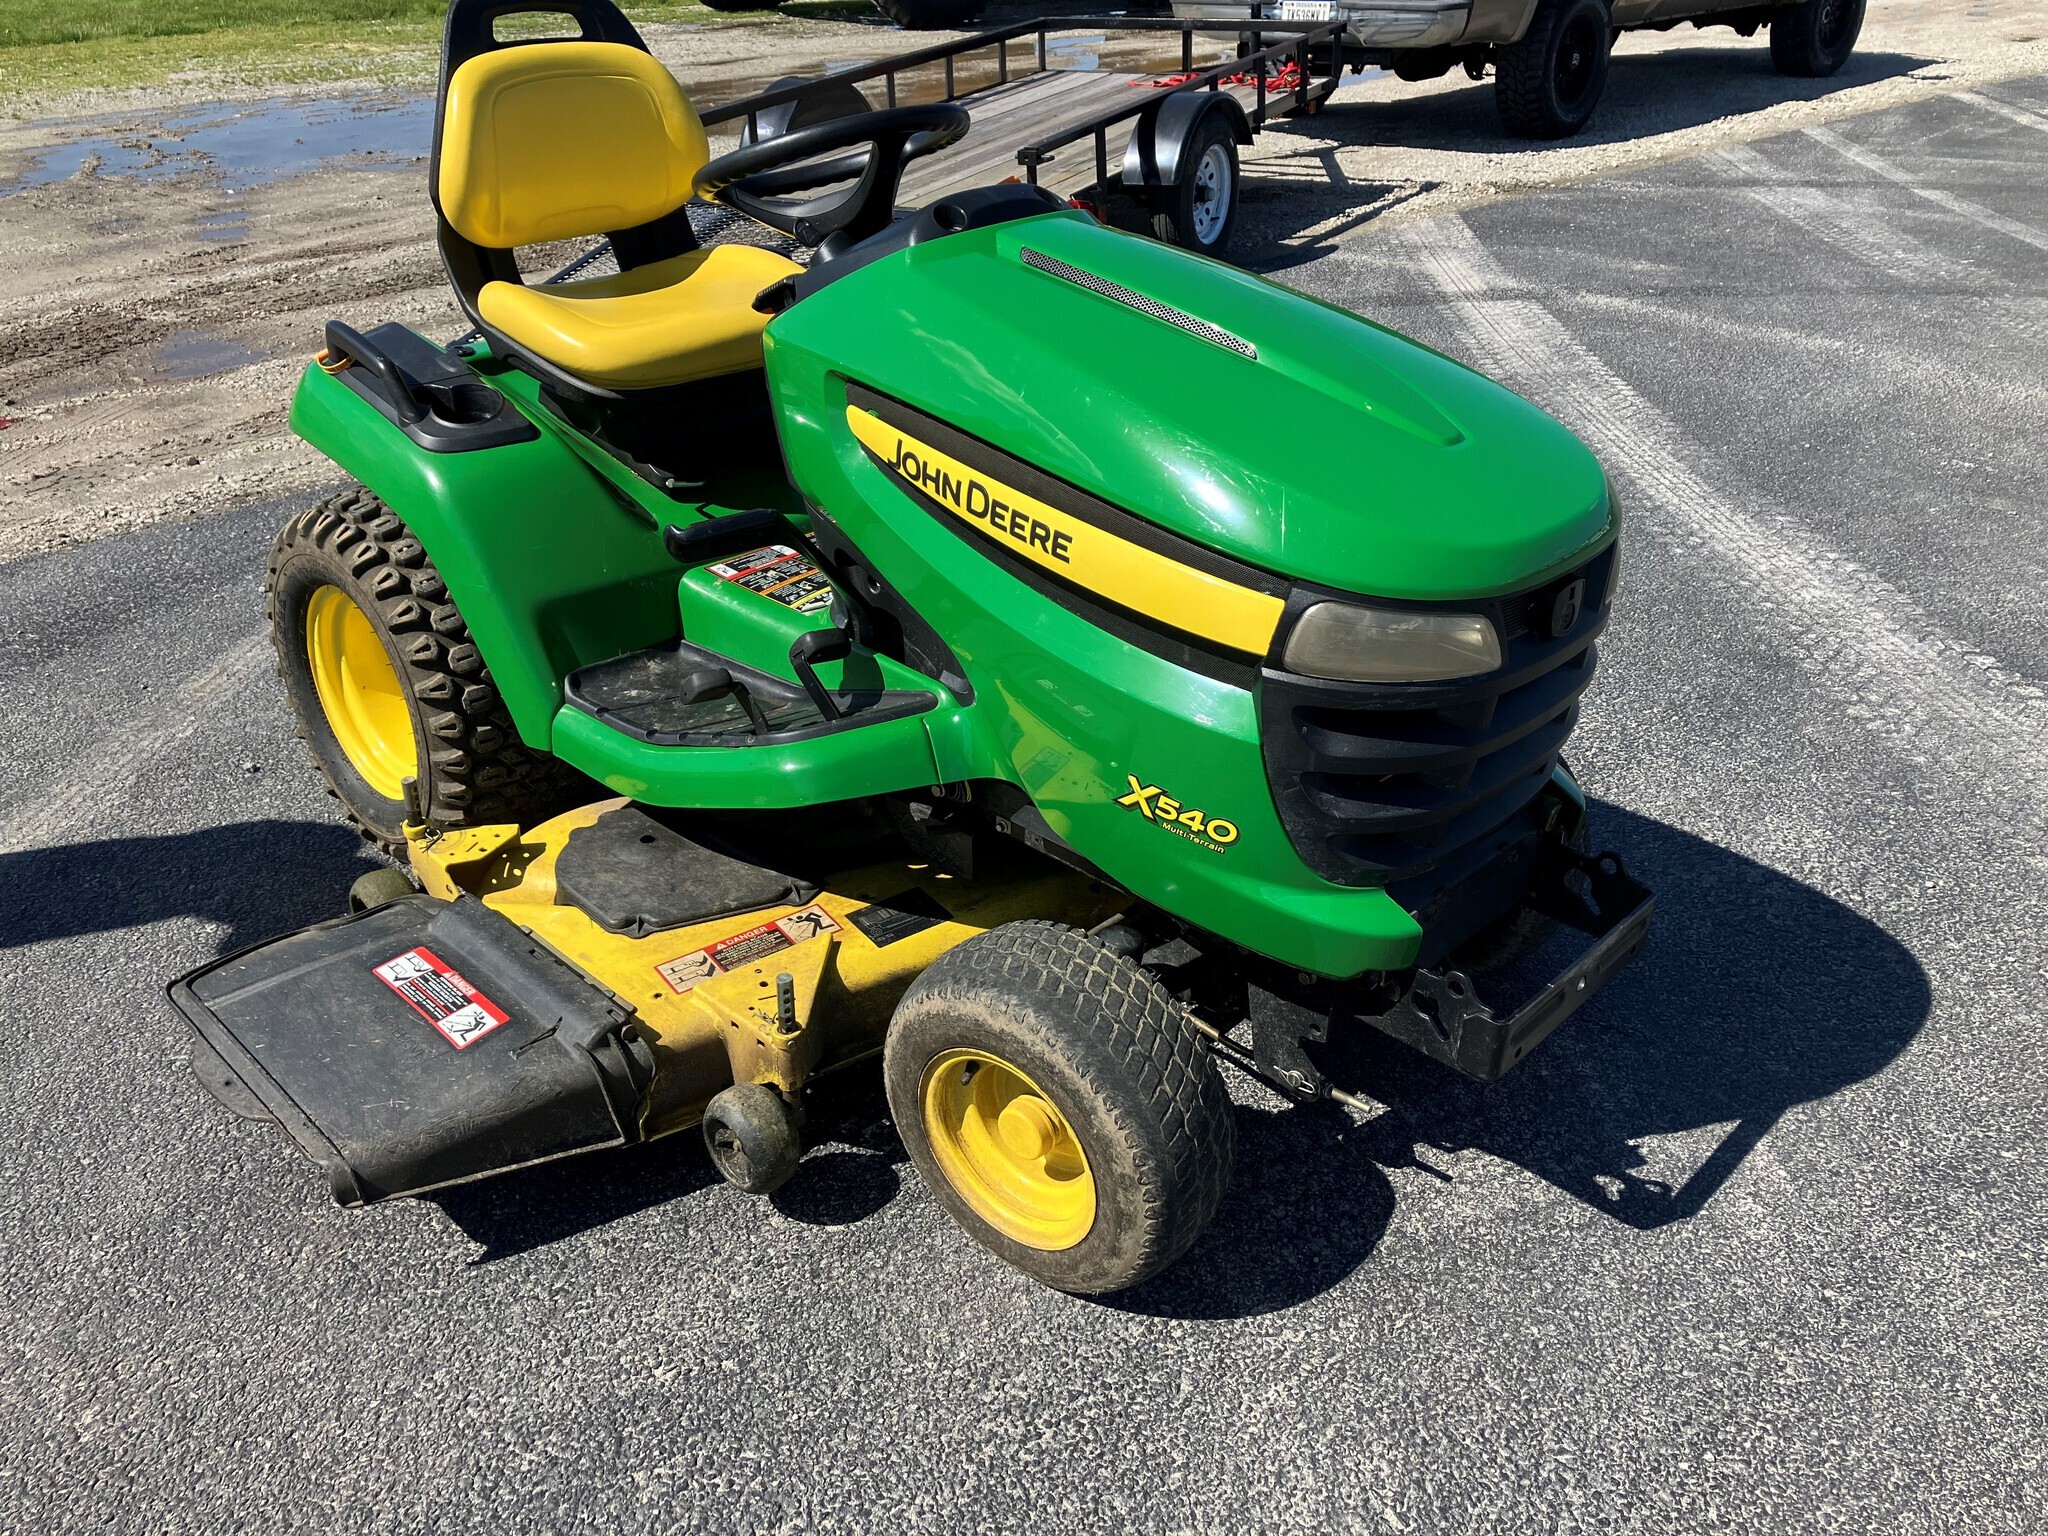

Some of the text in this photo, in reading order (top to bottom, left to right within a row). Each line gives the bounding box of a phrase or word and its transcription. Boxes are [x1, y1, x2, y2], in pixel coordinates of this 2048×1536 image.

[886, 438, 1074, 564] JOHN DEERE
[1114, 773, 1240, 846] X540
[1162, 821, 1226, 855] Multi-Terrain
[726, 925, 769, 945] DANGER
[447, 974, 476, 997] DANGER
